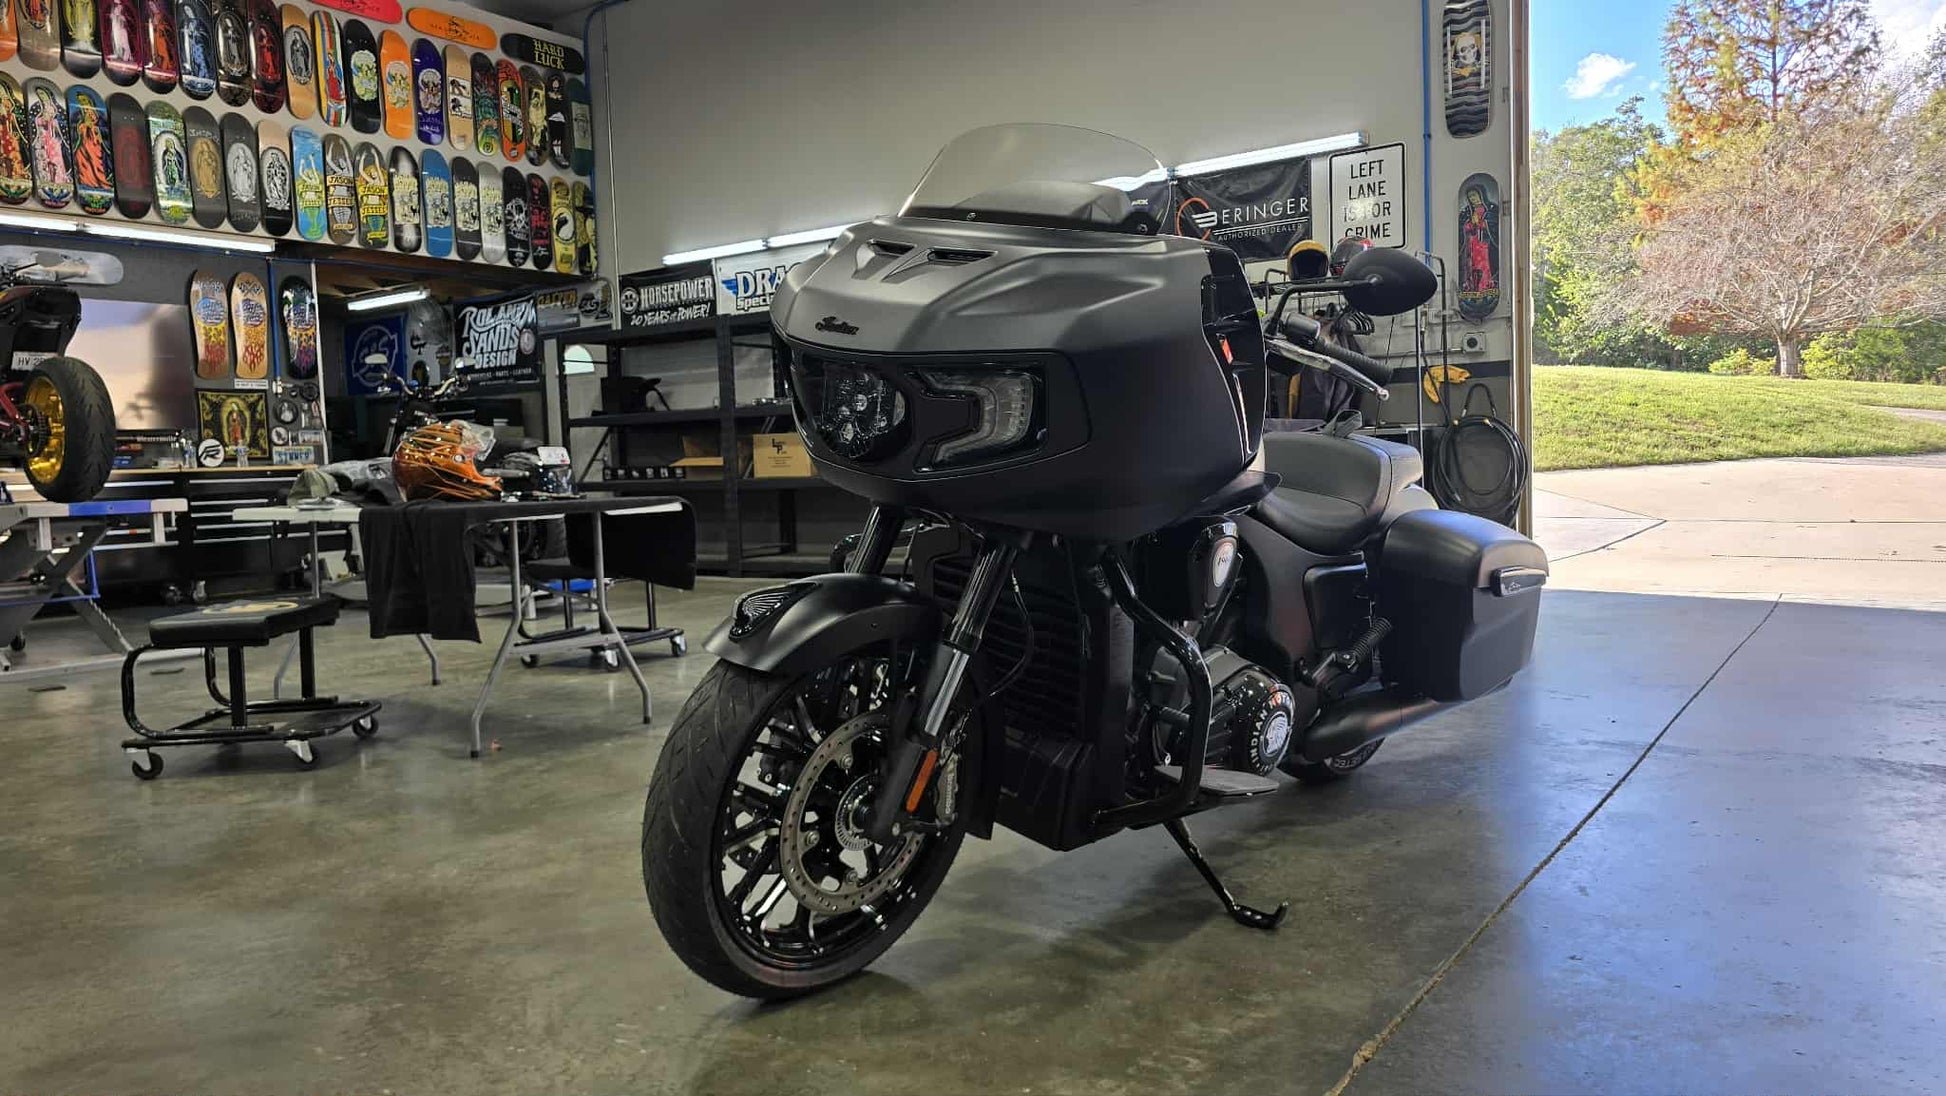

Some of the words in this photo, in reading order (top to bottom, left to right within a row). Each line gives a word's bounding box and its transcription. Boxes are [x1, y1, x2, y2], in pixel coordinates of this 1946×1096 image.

[533, 39, 565, 58] HARD
[533, 50, 565, 70] LUCK
[1350, 159, 1385, 180] LEFT
[1348, 180, 1387, 201] LANE
[1217, 229, 1267, 242] AUTHORIZED
[1269, 223, 1303, 236] DEALER
[639, 275, 715, 312] HORSEPOWER
[643, 309, 670, 328] YEARS
[676, 302, 710, 321] POWER!
[462, 323, 520, 360] SANDS
[474, 350, 518, 369] DESIGN
